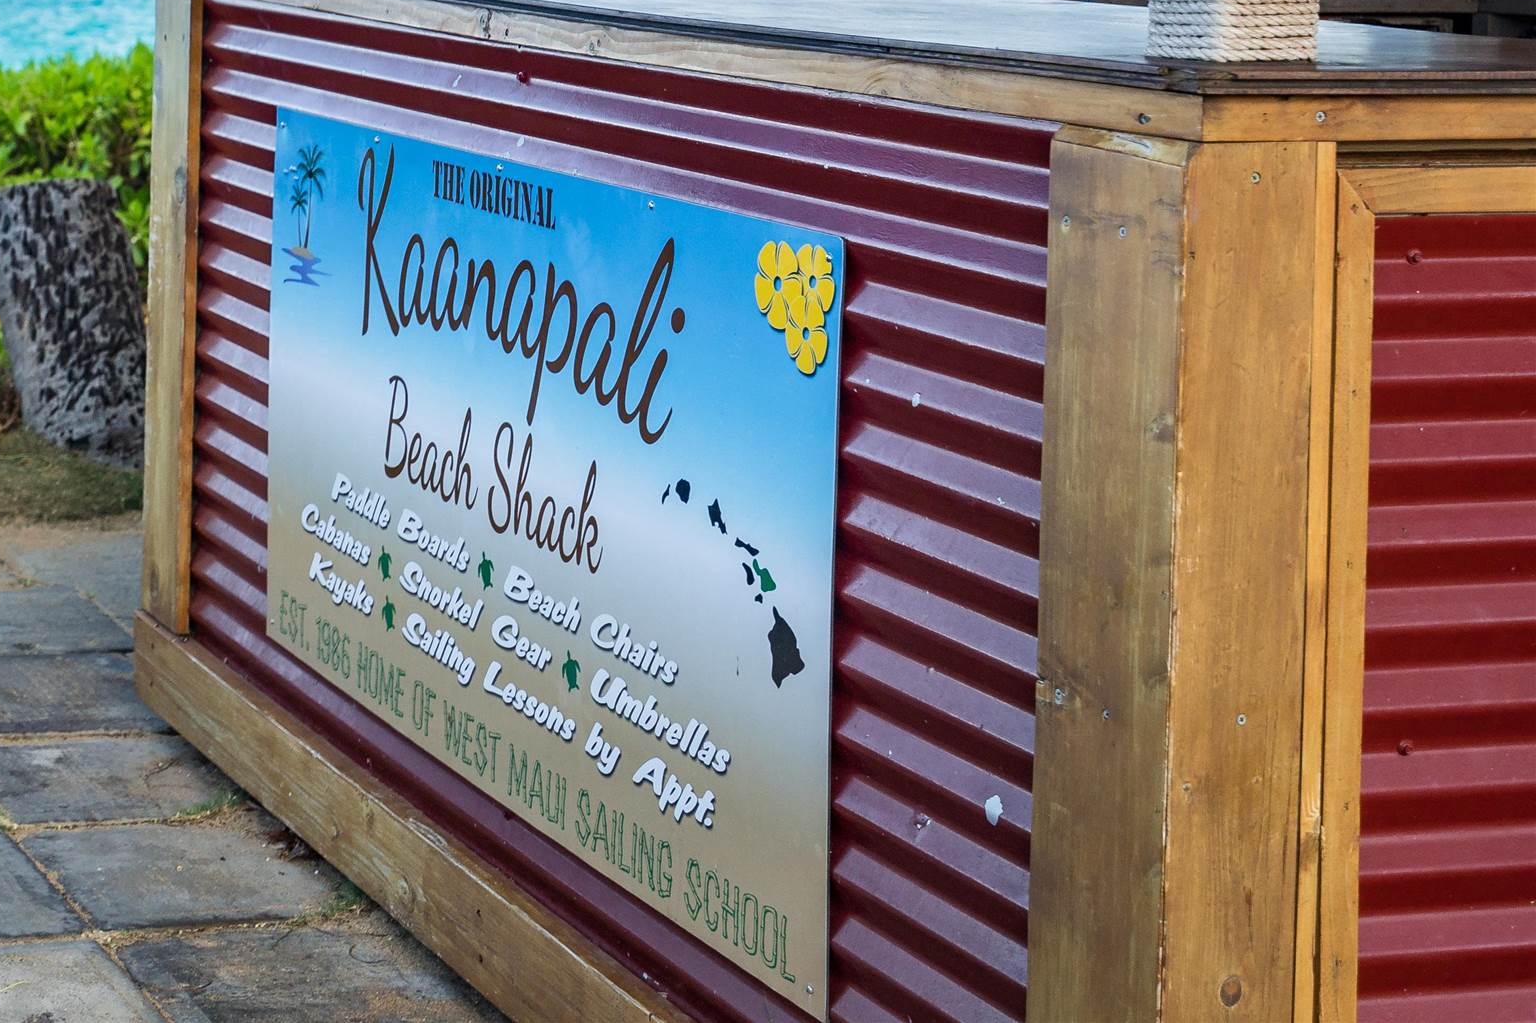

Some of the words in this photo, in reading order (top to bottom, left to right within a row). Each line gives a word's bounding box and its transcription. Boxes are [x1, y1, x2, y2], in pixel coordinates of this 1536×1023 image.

[357, 143, 686, 445] Kaanapali
[432, 160, 465, 205] THE
[469, 170, 556, 230] ORIGINAL
[331, 472, 391, 529] Paddle
[397, 508, 471, 573] Boards
[503, 565, 581, 633] Beach
[590, 613, 679, 685] Chairs
[384, 375, 478, 510] Beach
[487, 421, 603, 574] Shack
[301, 503, 371, 566] Cabanas
[399, 561, 485, 631] Snorkel
[491, 614, 553, 671] Gear
[590, 667, 732, 774] Umbrellas
[309, 552, 374, 617] Kayaks
[402, 612, 476, 687] Sailing
[483, 661, 576, 742] Lessons
[584, 722, 622, 775] by
[632, 757, 716, 828] Appt.
[279, 589, 310, 651] EST.
[316, 616, 351, 680] 1986
[357, 641, 406, 719] HOME
[413, 680, 437, 737] OF
[443, 699, 501, 783] WEST
[507, 743, 567, 830] MAUI
[575, 788, 673, 898] SAILING
[683, 858, 795, 984] SCHOOL
